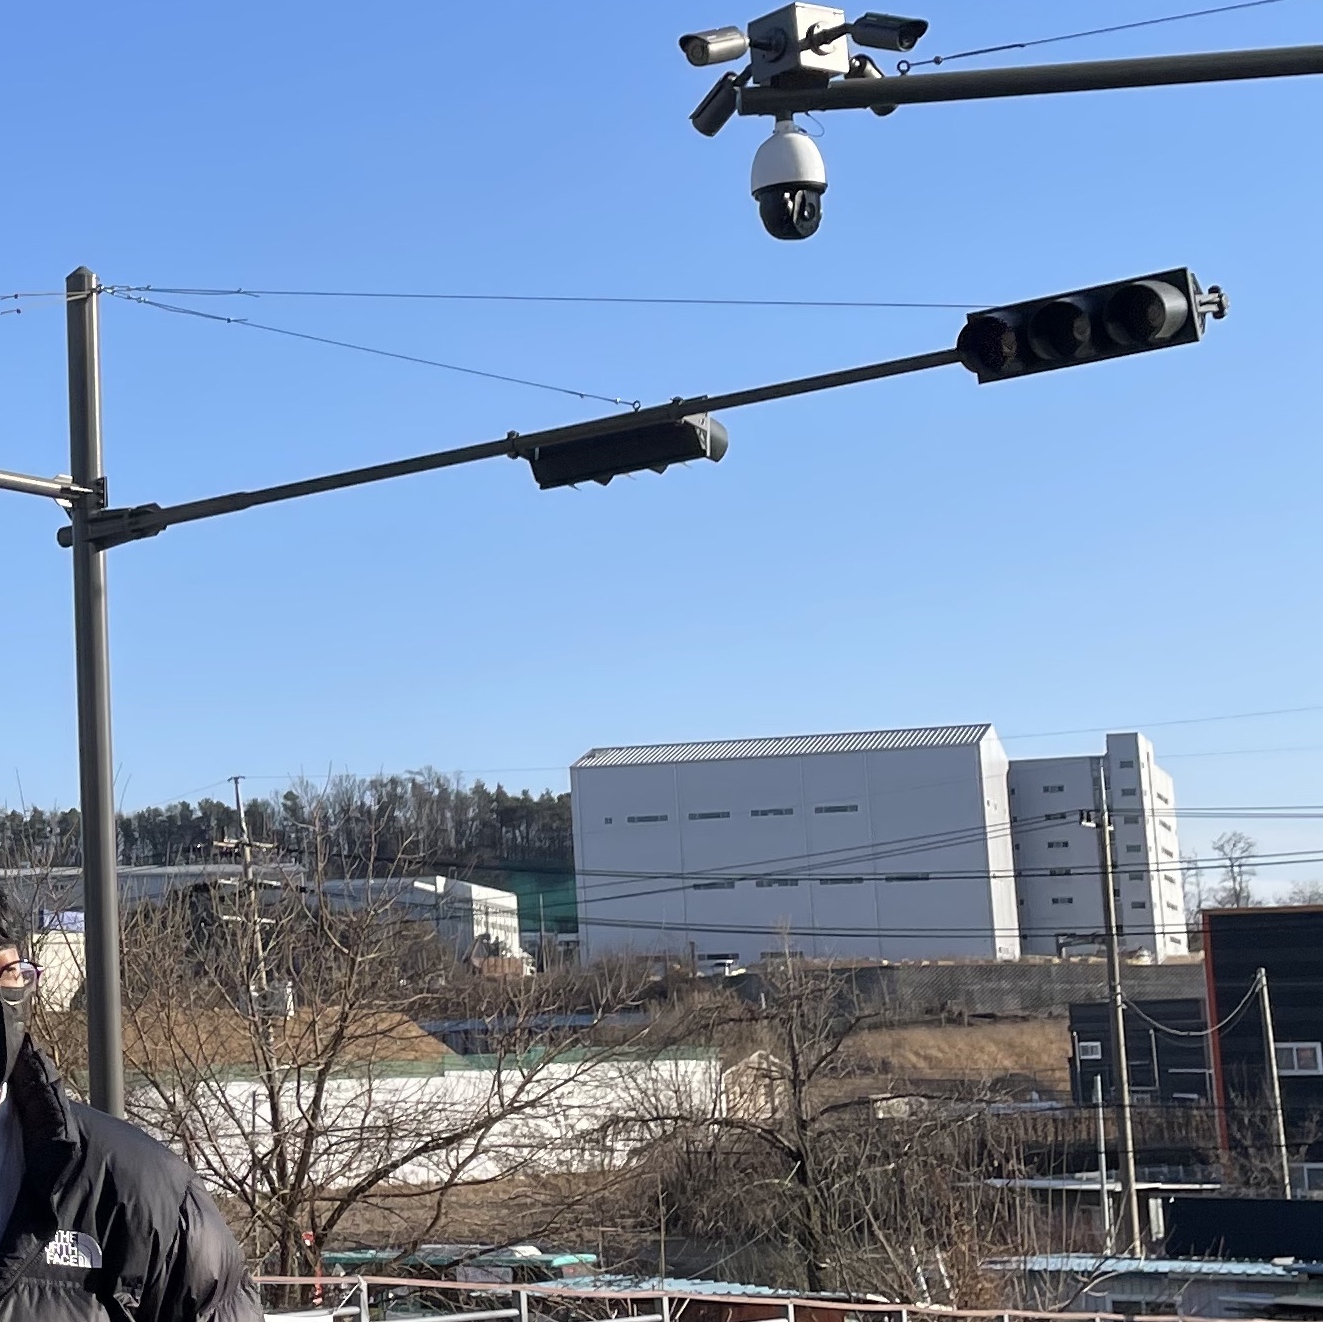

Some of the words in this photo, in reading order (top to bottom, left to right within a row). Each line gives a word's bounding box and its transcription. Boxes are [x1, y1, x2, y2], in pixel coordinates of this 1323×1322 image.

[55, 1230, 78, 1243] THE
[45, 1241, 78, 1256] RTH
[47, 1254, 79, 1267] FACE
